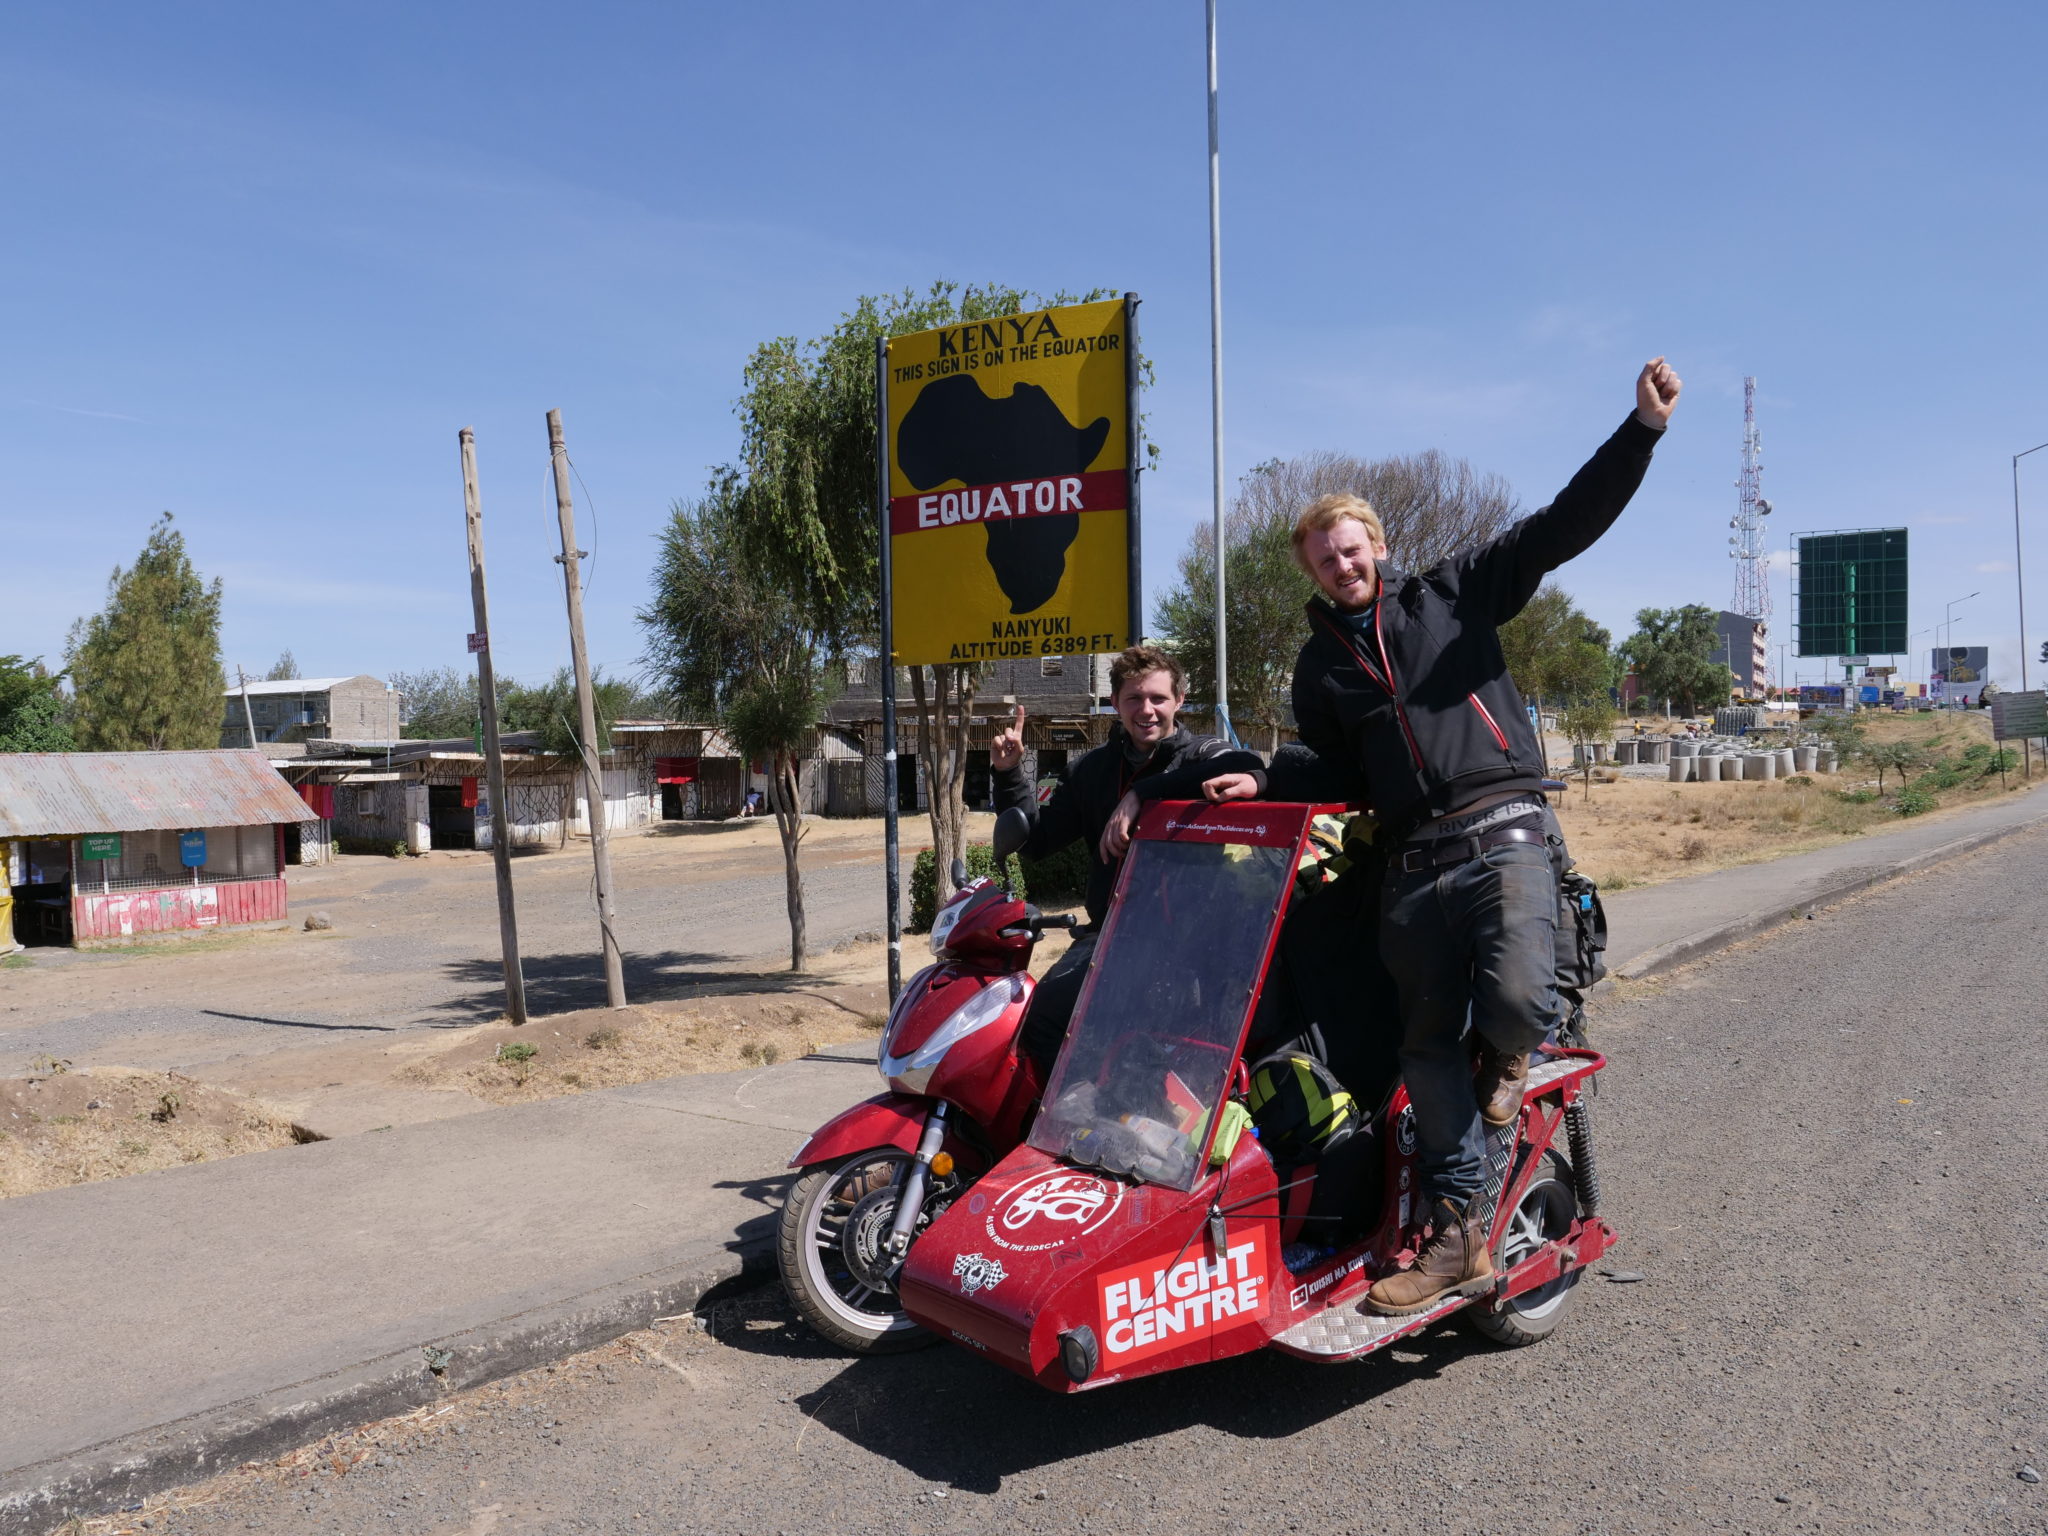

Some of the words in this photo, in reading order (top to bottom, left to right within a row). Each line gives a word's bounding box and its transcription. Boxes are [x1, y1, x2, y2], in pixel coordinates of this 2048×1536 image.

[939, 315, 1062, 358] KENYA
[894, 361, 923, 383] THIS
[928, 357, 960, 377] SIGN
[964, 354, 979, 372] IS
[984, 349, 1004, 368] ON
[1010, 344, 1038, 363] THE
[1043, 335, 1120, 357] EQUATOR
[917, 477, 1084, 529] EQUATOR
[992, 617, 1071, 639] NANYUKI
[950, 639, 1033, 660] ALTITUDE
[1040, 636, 1087, 654] 6389
[1091, 635, 1118, 651] FT.
[1438, 810, 1496, 834] RIVER
[986, 1224, 997, 1238] SEEN
[991, 1235, 1010, 1249] FROM
[1009, 1243, 1024, 1251] THE
[1024, 1240, 1065, 1252] SIDECAR
[1104, 1241, 1256, 1321] FLIGHT
[1309, 1272, 1334, 1296] KUISHI
[1334, 1265, 1347, 1280] NA
[1347, 1250, 1374, 1273] KUISHI
